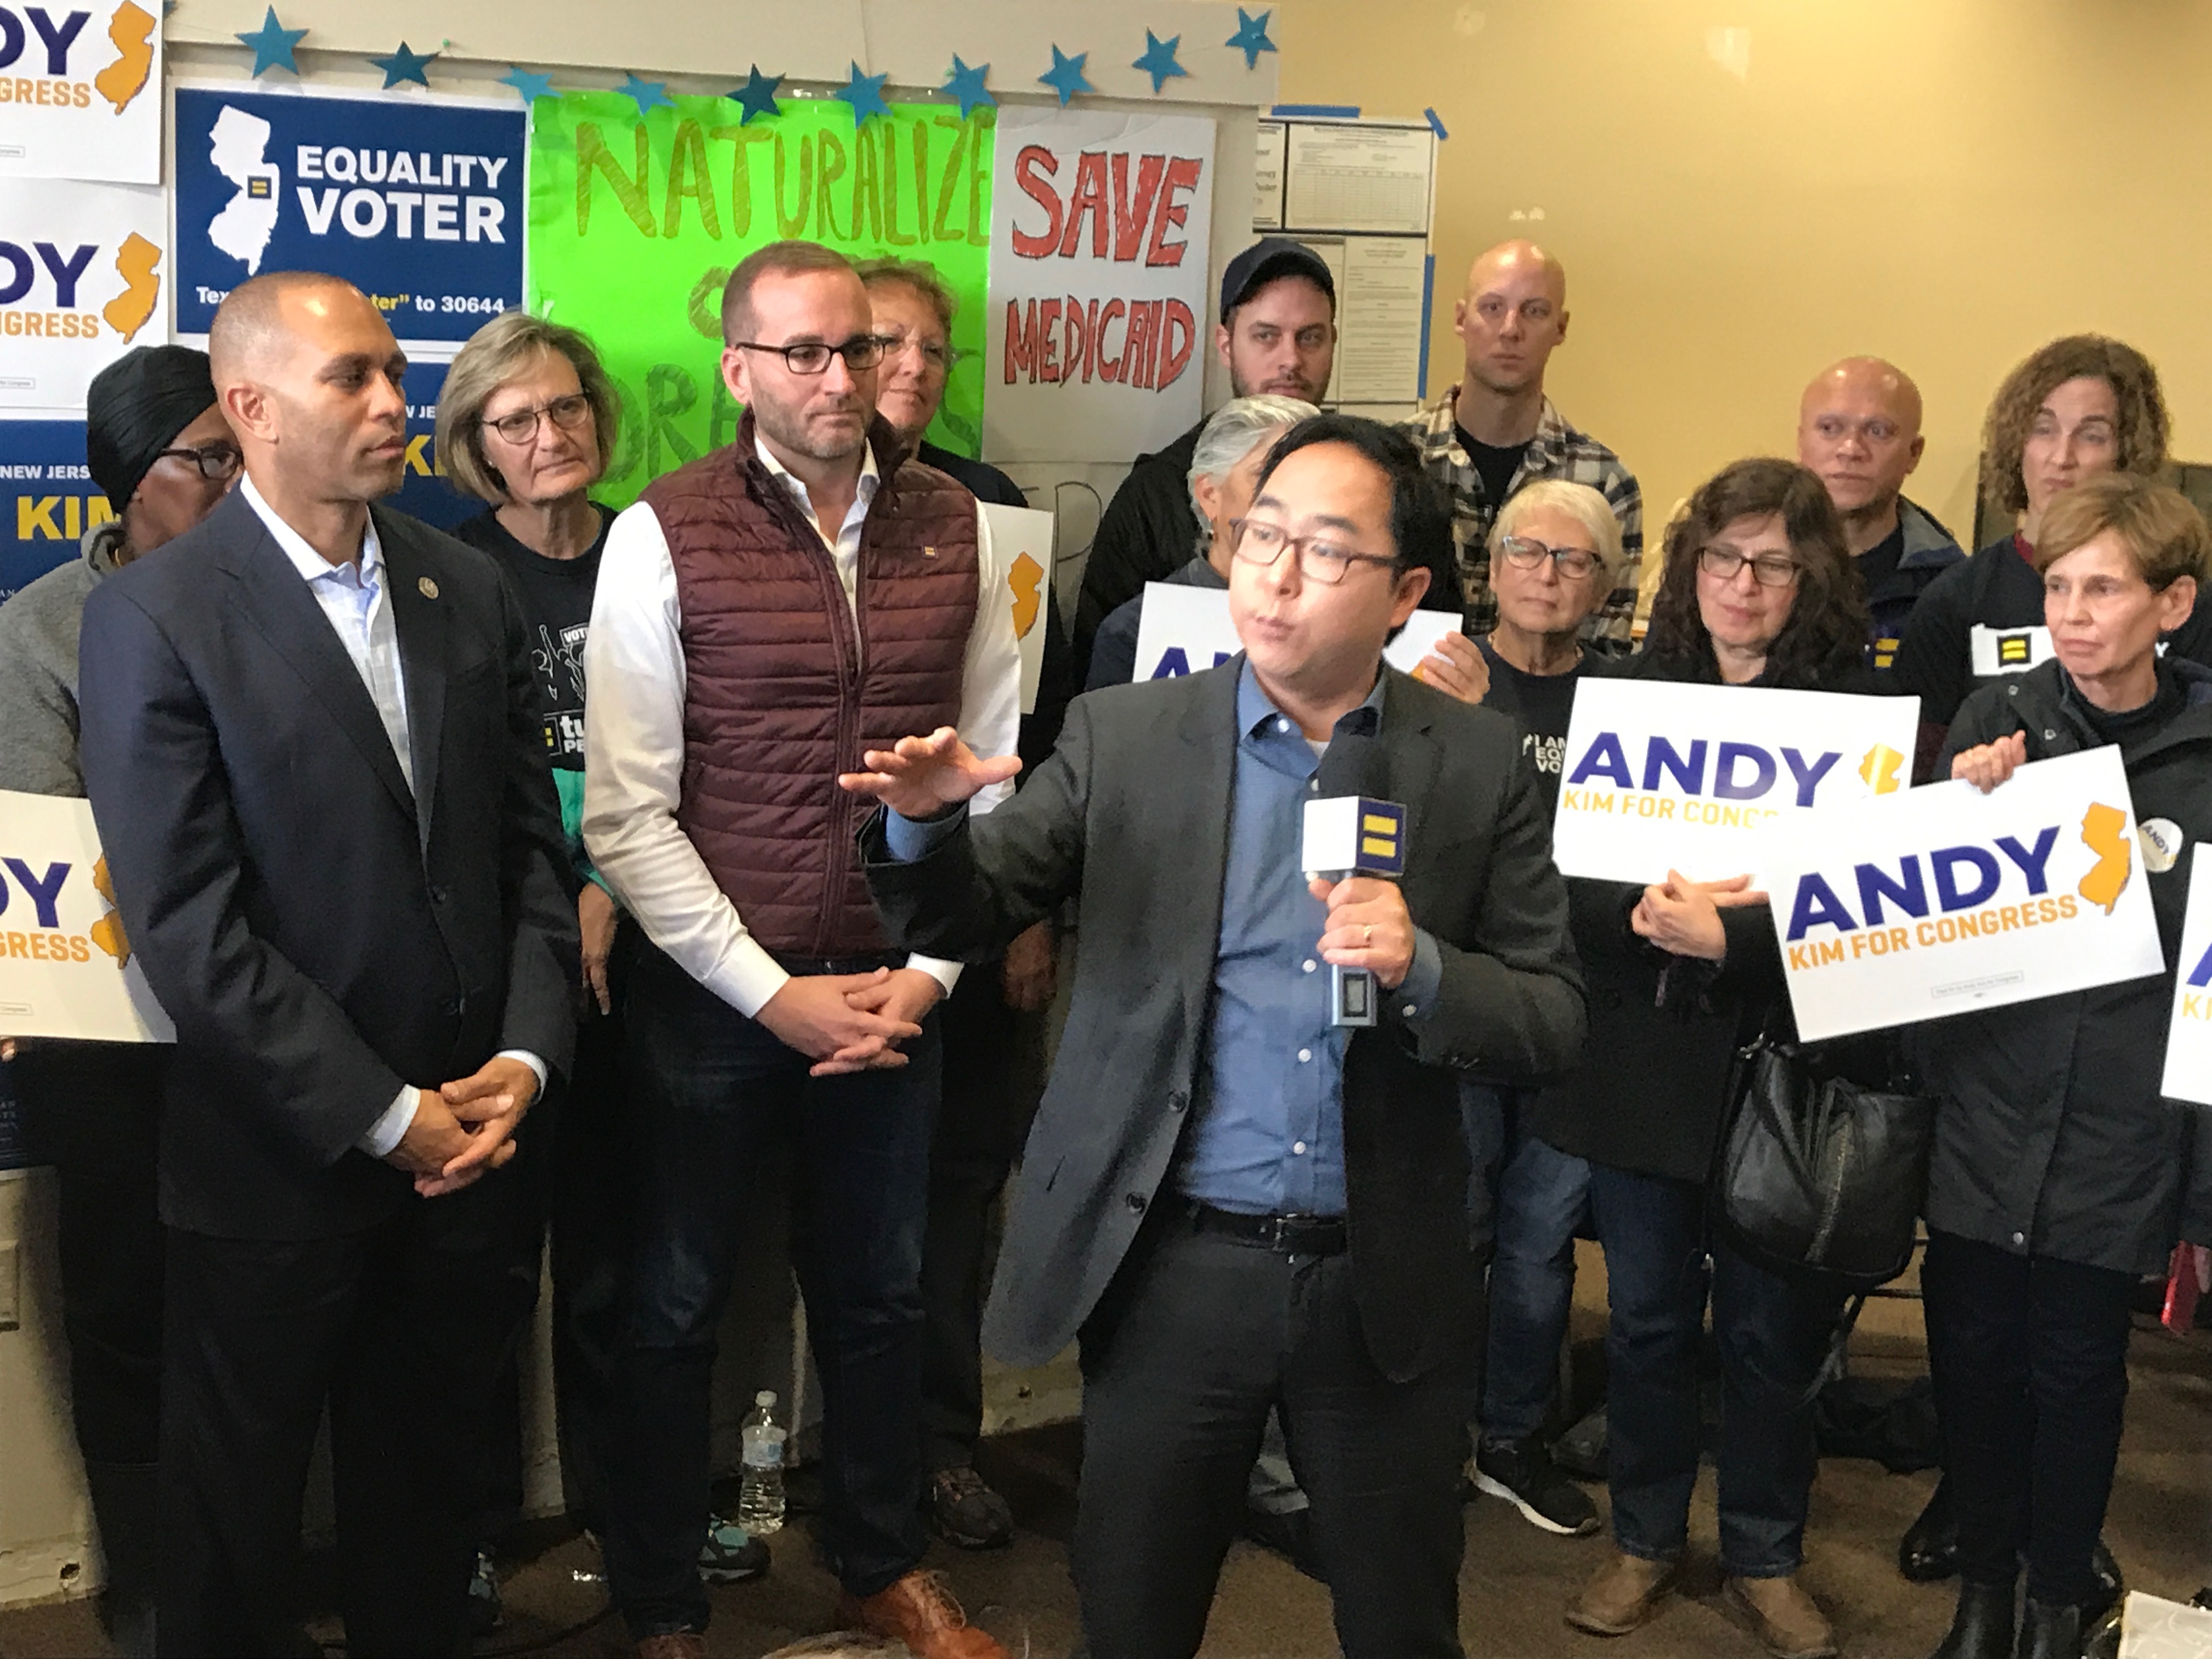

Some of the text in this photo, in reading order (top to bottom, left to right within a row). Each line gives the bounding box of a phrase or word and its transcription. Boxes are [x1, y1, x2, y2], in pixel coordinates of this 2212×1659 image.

[297, 145, 509, 189] EQUALITY
[576, 114, 995, 246] NATURALIZE
[296, 187, 507, 245] VOTER
[1012, 144, 1204, 268] SAVE
[0, 311, 99, 339] GRESS
[415, 297, 436, 312] to
[441, 297, 505, 313] 30644
[1004, 295, 1196, 394] MEDICAID
[0, 465, 42, 479] NEW
[564, 628, 589, 643] VOT
[1567, 731, 1844, 809] ANDY
[1562, 789, 1615, 814] KIM
[1622, 794, 1676, 820] FOR
[1786, 824, 2061, 943] ANDY
[1788, 894, 2079, 972] KIM FOR CONGRESS
